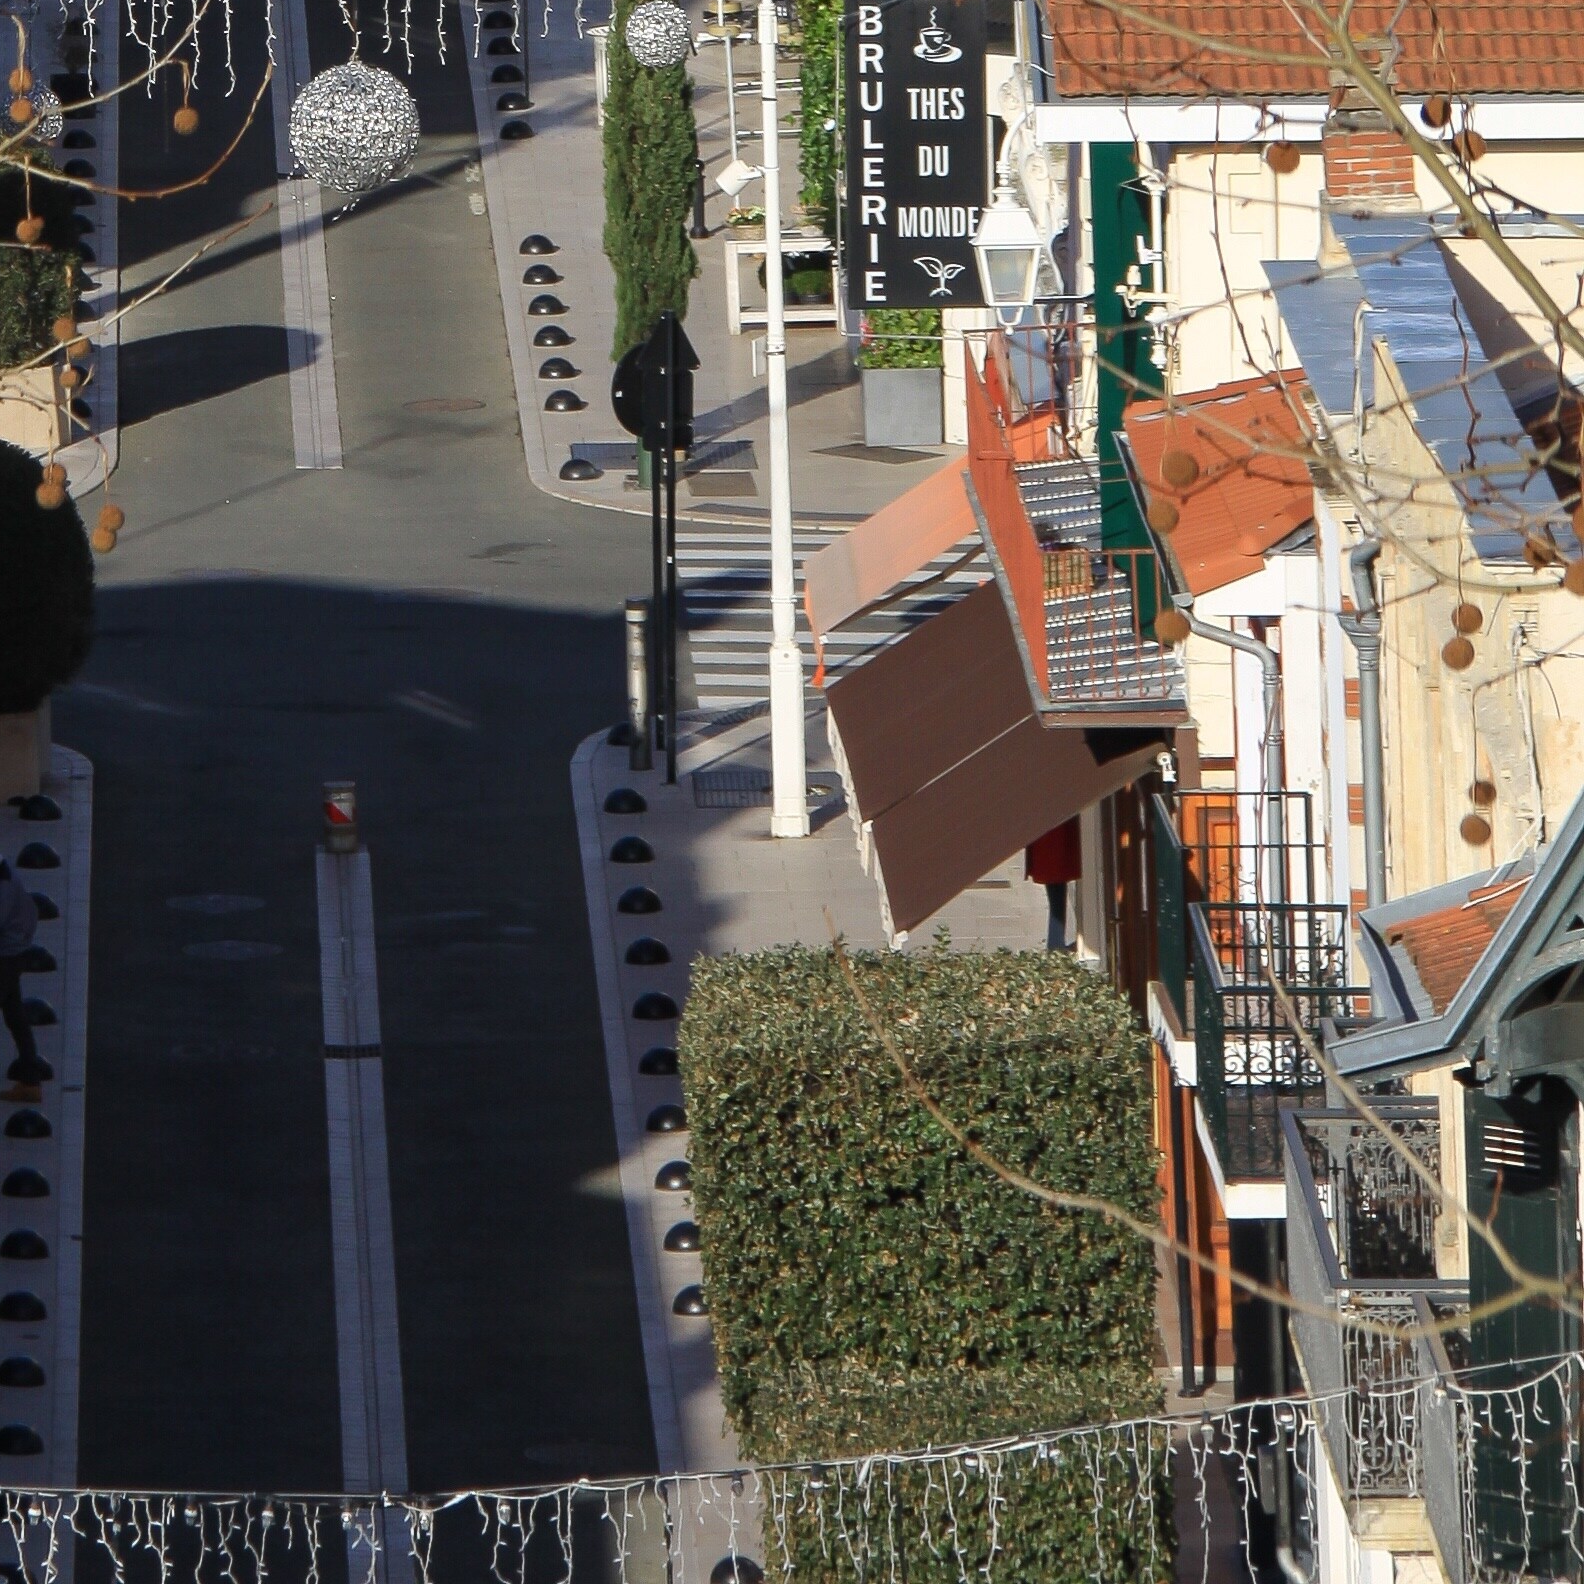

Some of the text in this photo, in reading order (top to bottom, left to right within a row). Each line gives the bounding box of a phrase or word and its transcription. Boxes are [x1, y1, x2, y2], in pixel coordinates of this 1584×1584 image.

[906, 87, 966, 121] THES
[858, 5, 887, 302] BRULERIE
[918, 145, 950, 177] DU
[897, 206, 980, 238] MONDE
